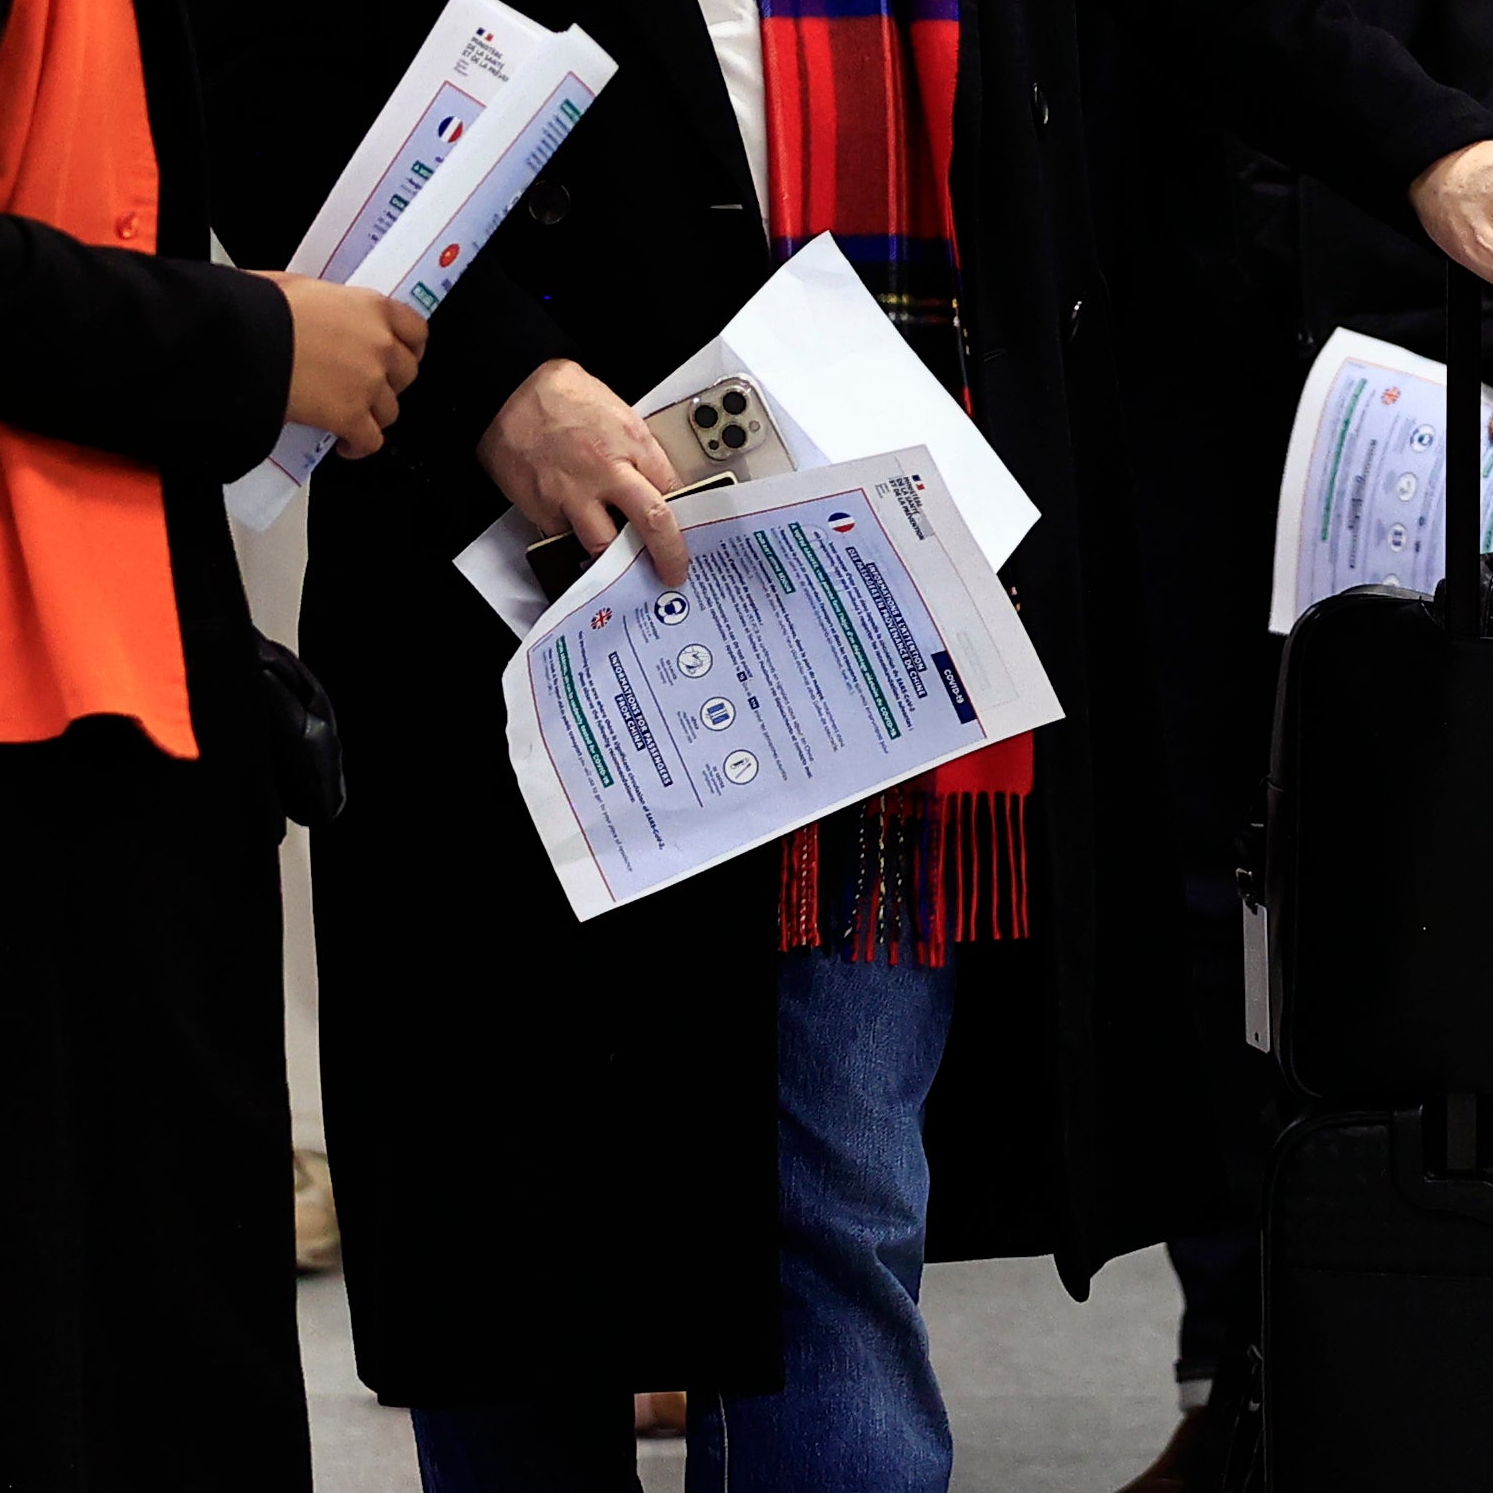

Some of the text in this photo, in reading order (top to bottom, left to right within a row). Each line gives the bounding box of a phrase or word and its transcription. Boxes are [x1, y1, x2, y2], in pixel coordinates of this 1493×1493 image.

[853, 560, 879, 598] PASSAGERS
[865, 563, 900, 616] INFORMATIONS
[872, 597, 885, 609] EN
[878, 609, 909, 658] PROVENANCE
[902, 658, 914, 669] DE
[907, 670, 926, 696] CHINE
[942, 668, 965, 704] COVID-19
[609, 652, 671, 786] INFORMATIONS FOR PASSENGERS
[615, 694, 643, 749] FROM CHINA
